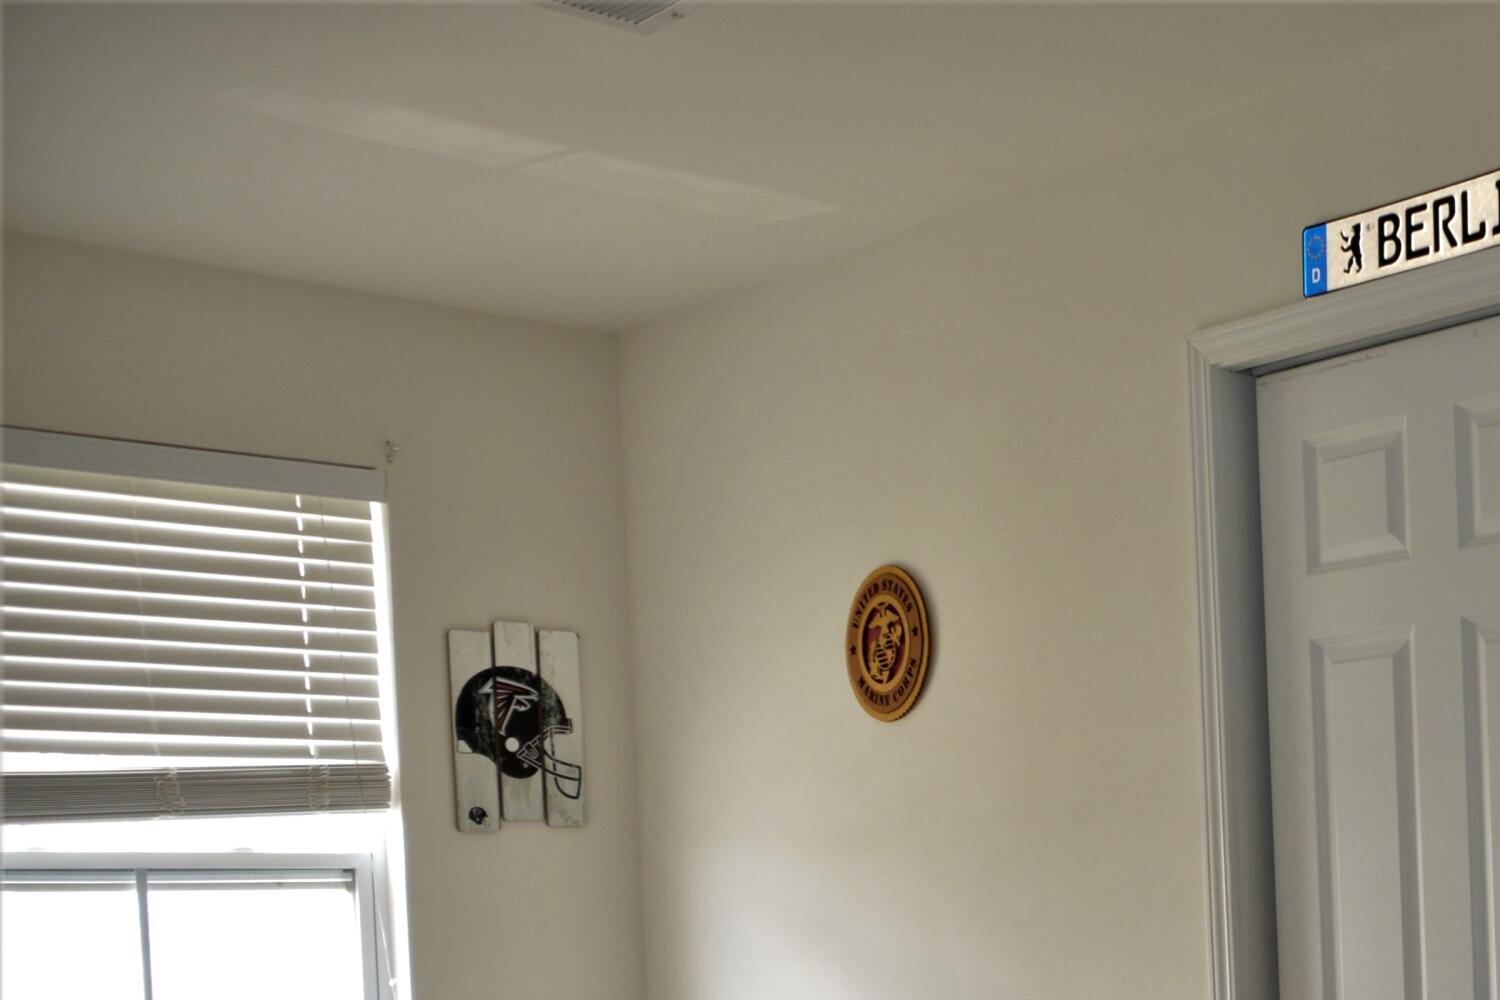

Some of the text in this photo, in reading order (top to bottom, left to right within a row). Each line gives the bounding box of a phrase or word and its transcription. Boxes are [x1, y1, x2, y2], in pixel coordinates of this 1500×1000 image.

[1312, 268, 1321, 284] D
[852, 579, 913, 629] UNITED STATES
[858, 657, 917, 706] MARINE CORPS
